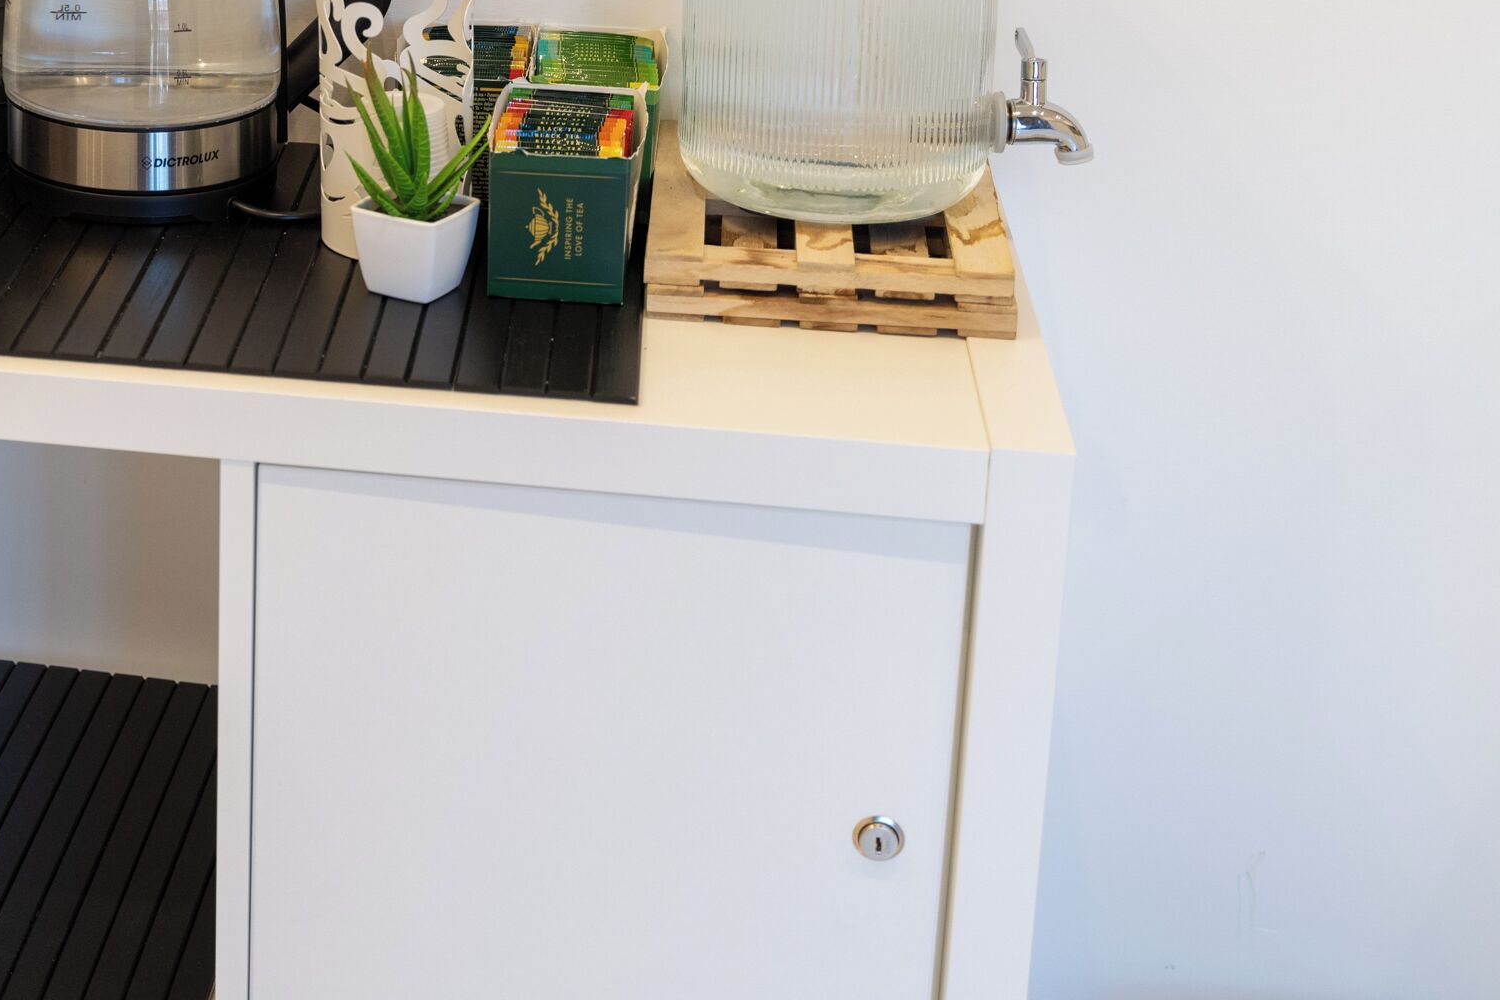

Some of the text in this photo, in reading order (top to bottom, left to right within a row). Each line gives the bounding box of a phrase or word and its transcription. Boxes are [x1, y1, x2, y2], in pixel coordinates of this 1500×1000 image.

[153, 149, 220, 168] DICTROLUX
[564, 198, 574, 260] INSPIRING THE
[575, 202, 585, 257] LOVE OF TEA
